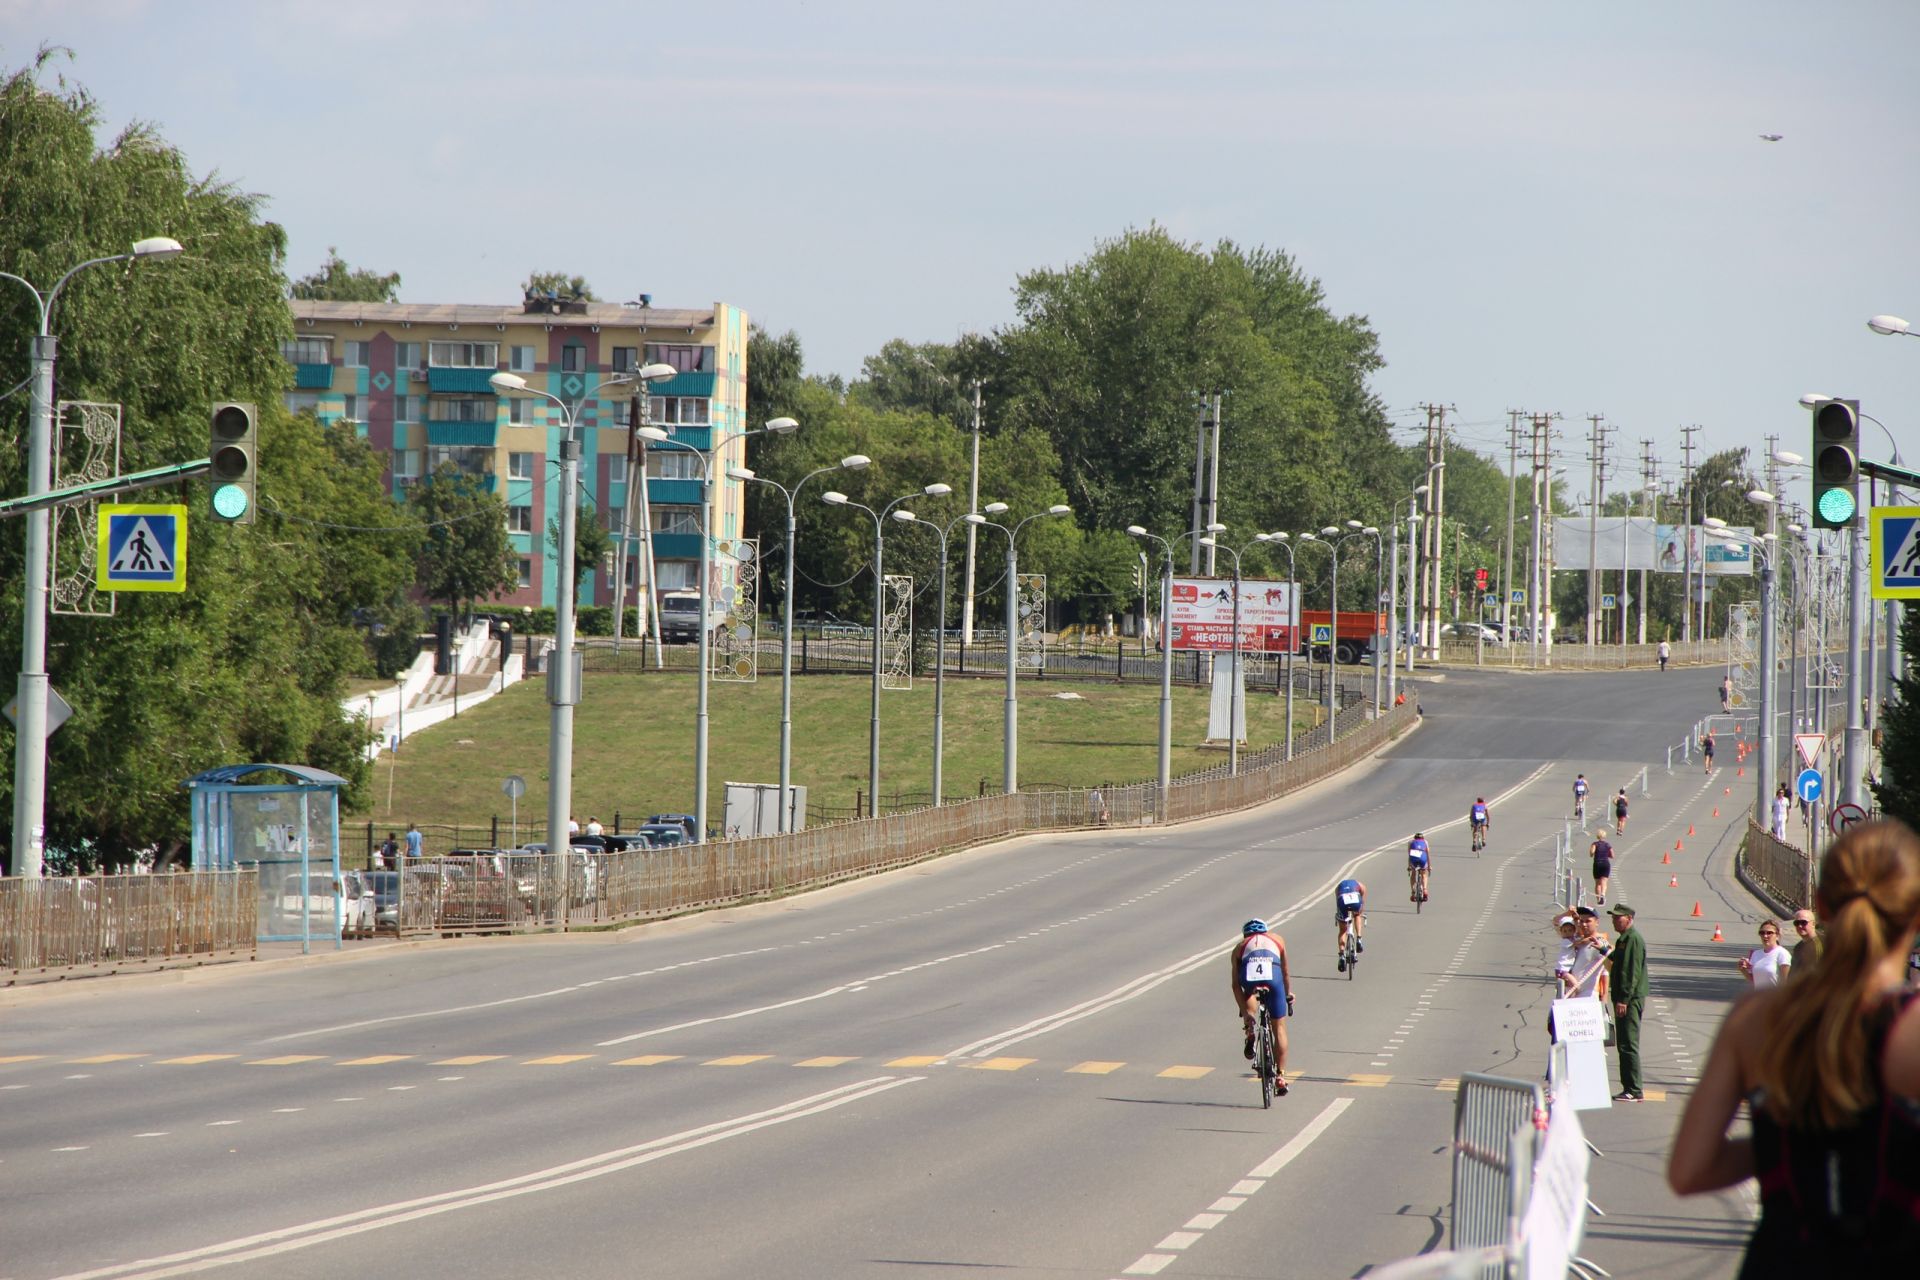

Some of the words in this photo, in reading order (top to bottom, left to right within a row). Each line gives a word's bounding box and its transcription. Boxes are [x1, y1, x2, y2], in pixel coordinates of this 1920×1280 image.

[1190, 632, 1252, 643] «НЕФТЯНК»
[1256, 963, 1263, 975] 4
[1568, 1008, 1588, 1017] ЗОНА
[1562, 1018, 1597, 1027] ПИТАНИЯ
[1568, 1029, 1594, 1037] КОНЕЦ
